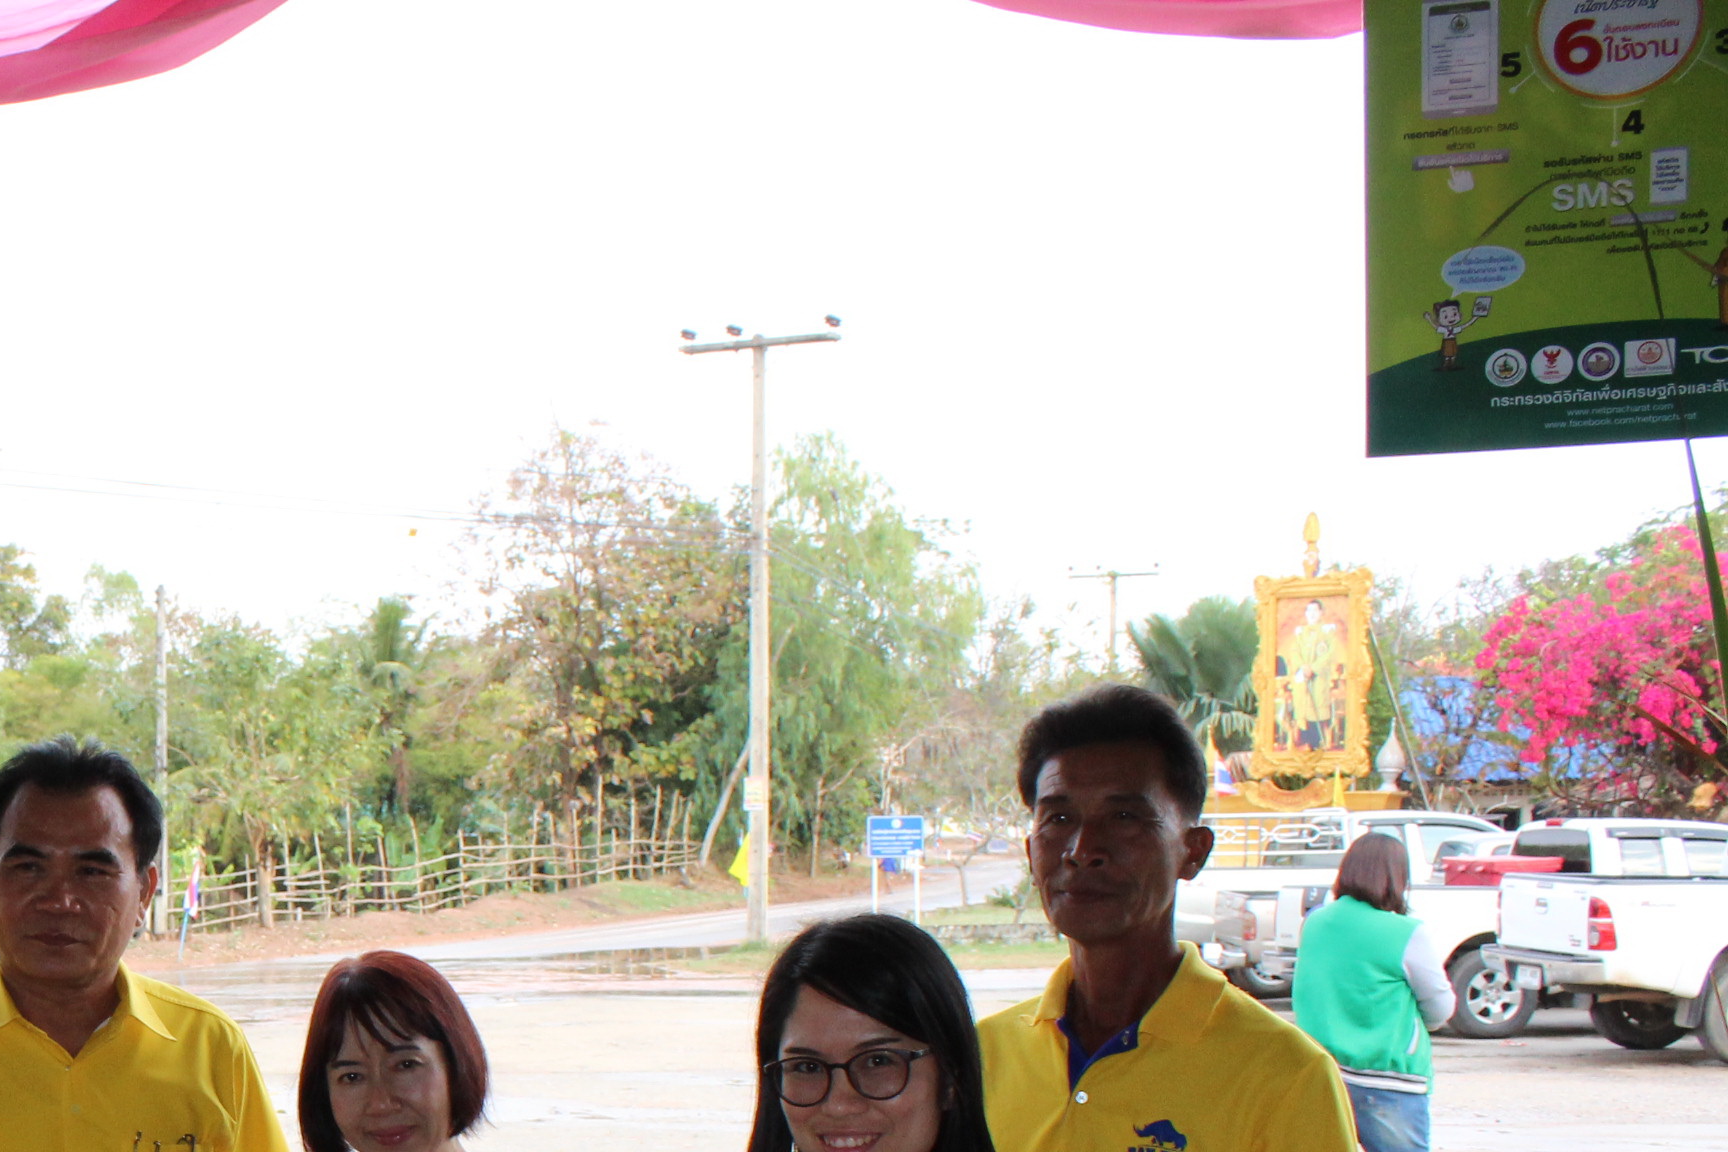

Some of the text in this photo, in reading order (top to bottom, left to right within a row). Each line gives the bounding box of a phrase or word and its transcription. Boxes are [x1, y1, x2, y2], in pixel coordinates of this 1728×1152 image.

[1554, 18, 1680, 75] 6 ใช้งาน
[1501, 52, 1522, 78] 5
[1497, 122, 1520, 133] SMS
[1621, 109, 1645, 134] 4
[1618, 151, 1643, 162] SMS
[1551, 177, 1635, 212] SMS
[1544, 411, 1698, 430] www.facebook.com/netprachrat
